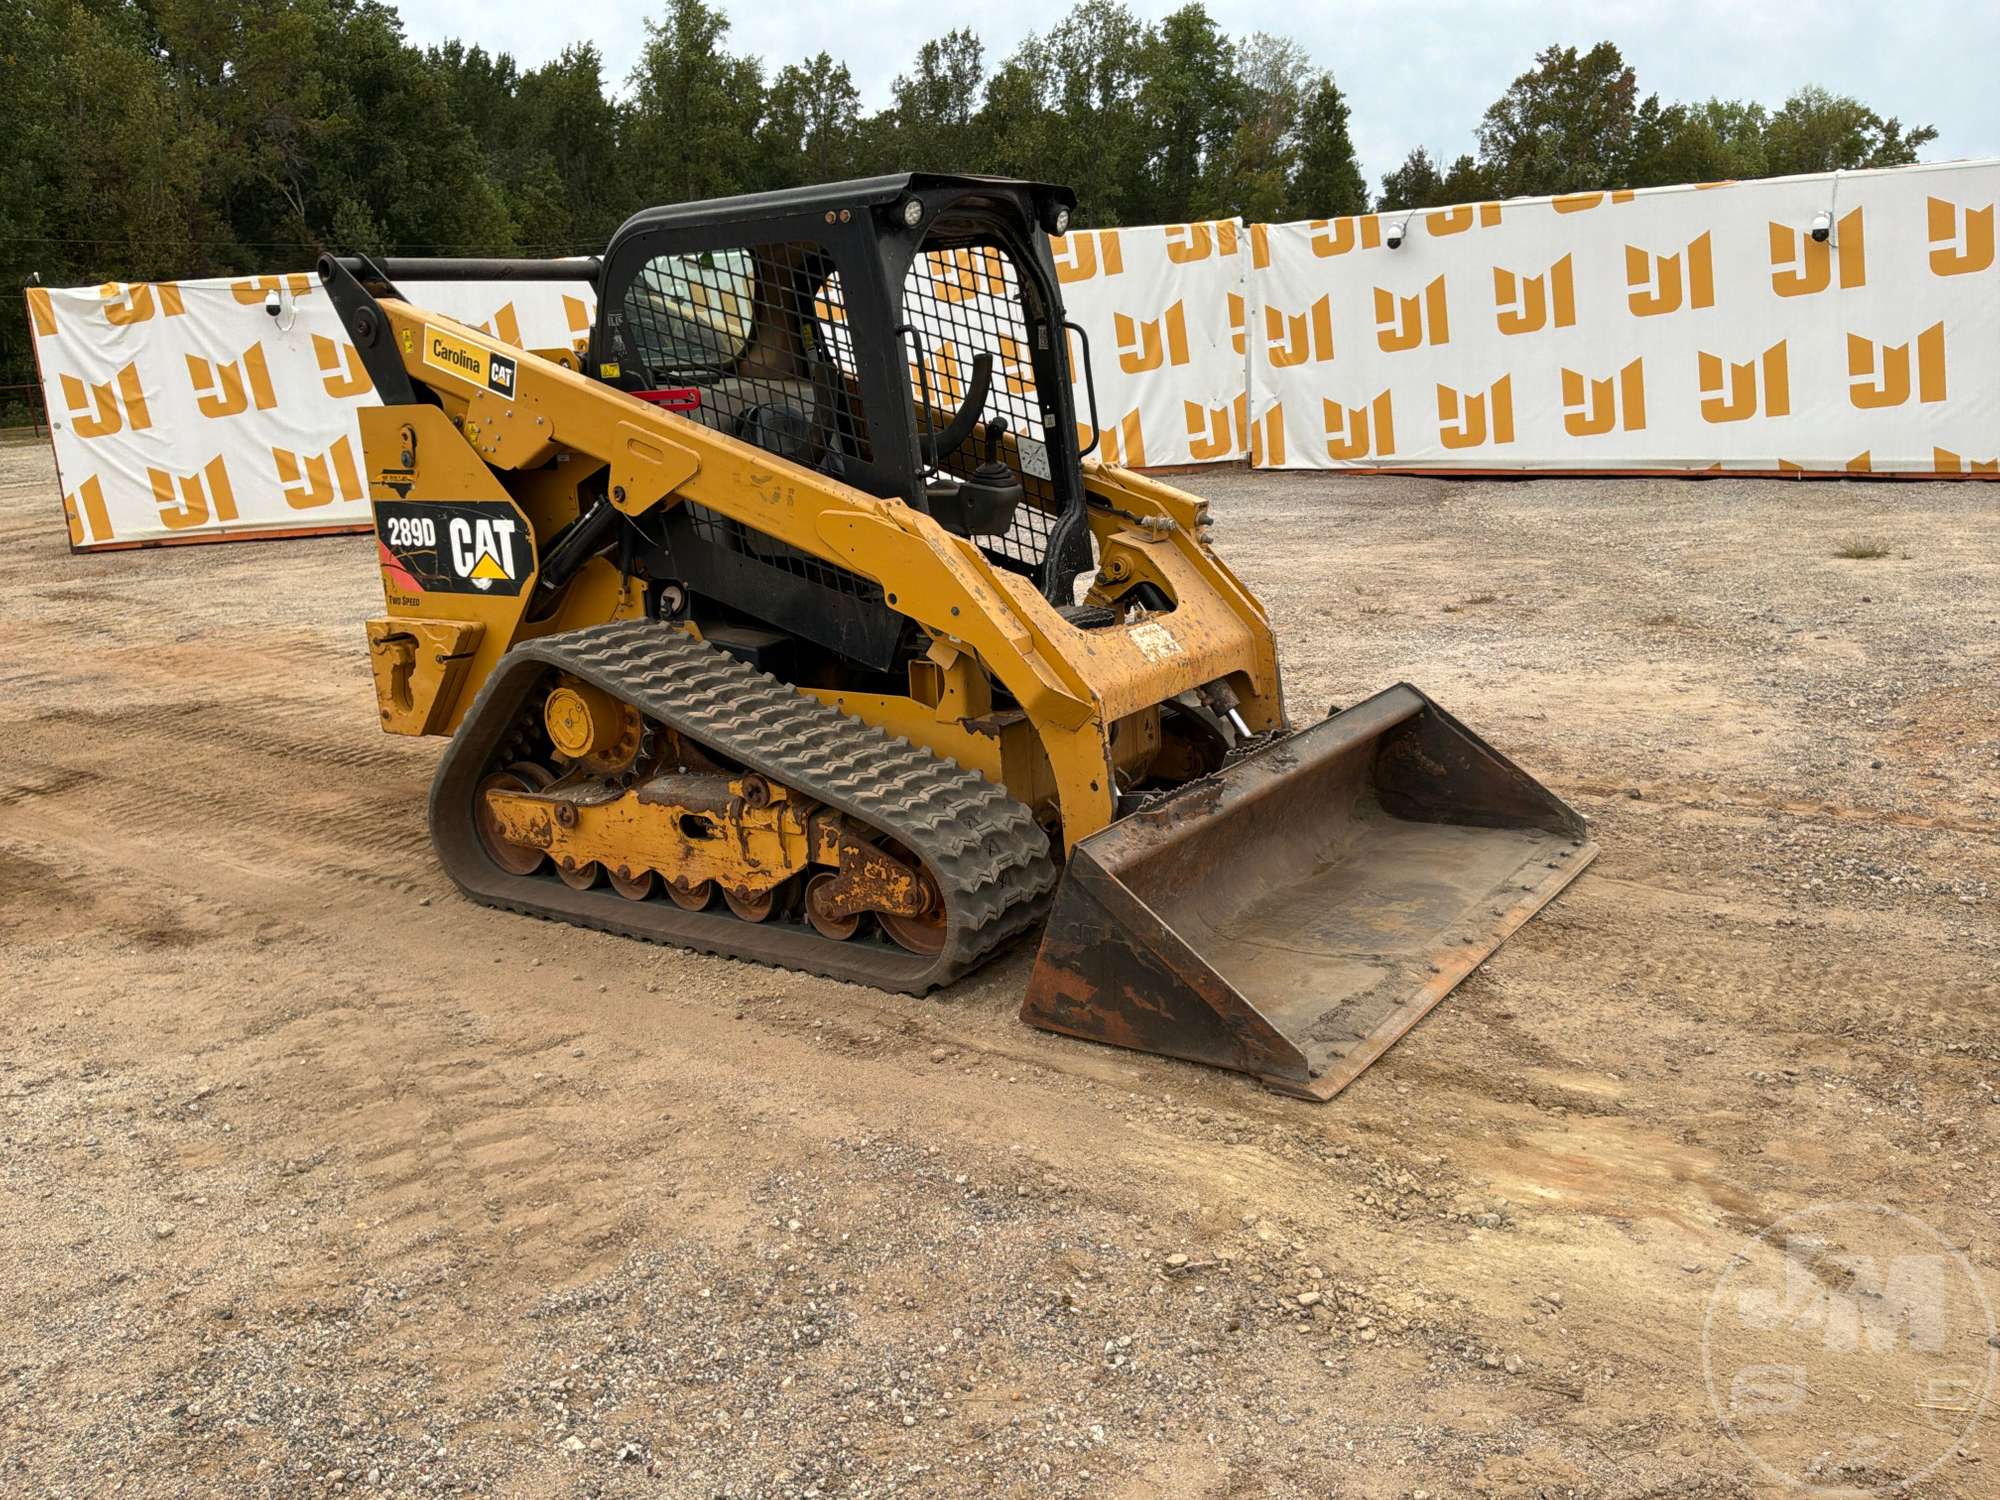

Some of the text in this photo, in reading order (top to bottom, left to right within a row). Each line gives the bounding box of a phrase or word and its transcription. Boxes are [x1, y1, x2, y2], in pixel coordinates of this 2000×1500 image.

[432, 338, 481, 375] Carolina
[491, 362, 513, 388] CAT
[387, 517, 437, 547] 289D
[449, 517, 515, 581] CAT
